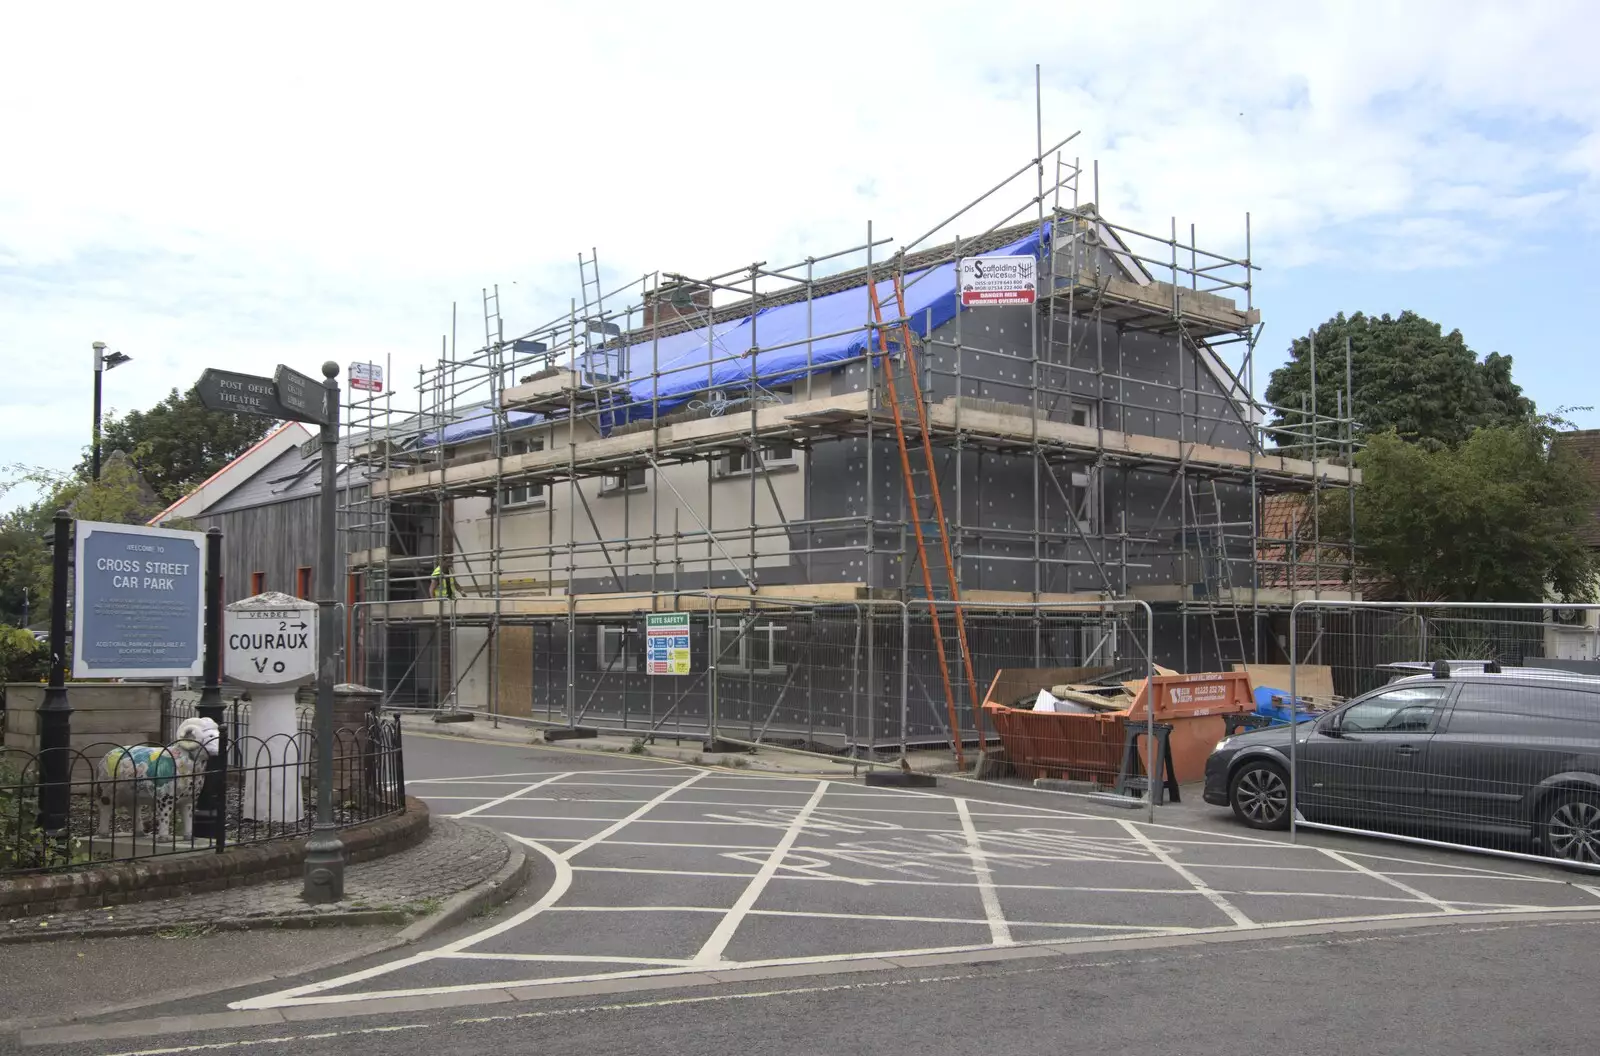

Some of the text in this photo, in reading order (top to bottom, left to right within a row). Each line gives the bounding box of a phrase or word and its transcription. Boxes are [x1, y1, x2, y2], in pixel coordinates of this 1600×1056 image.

[220, 379, 275, 396] POST OFFIC
[219, 392, 261, 407] THEATRE
[126, 544, 165, 554] WELCOME TO
[96, 557, 190, 576] CROSS STREET
[113, 575, 174, 590] CAR PARK
[279, 621, 287, 631] 2
[229, 633, 308, 650] COURAUX
